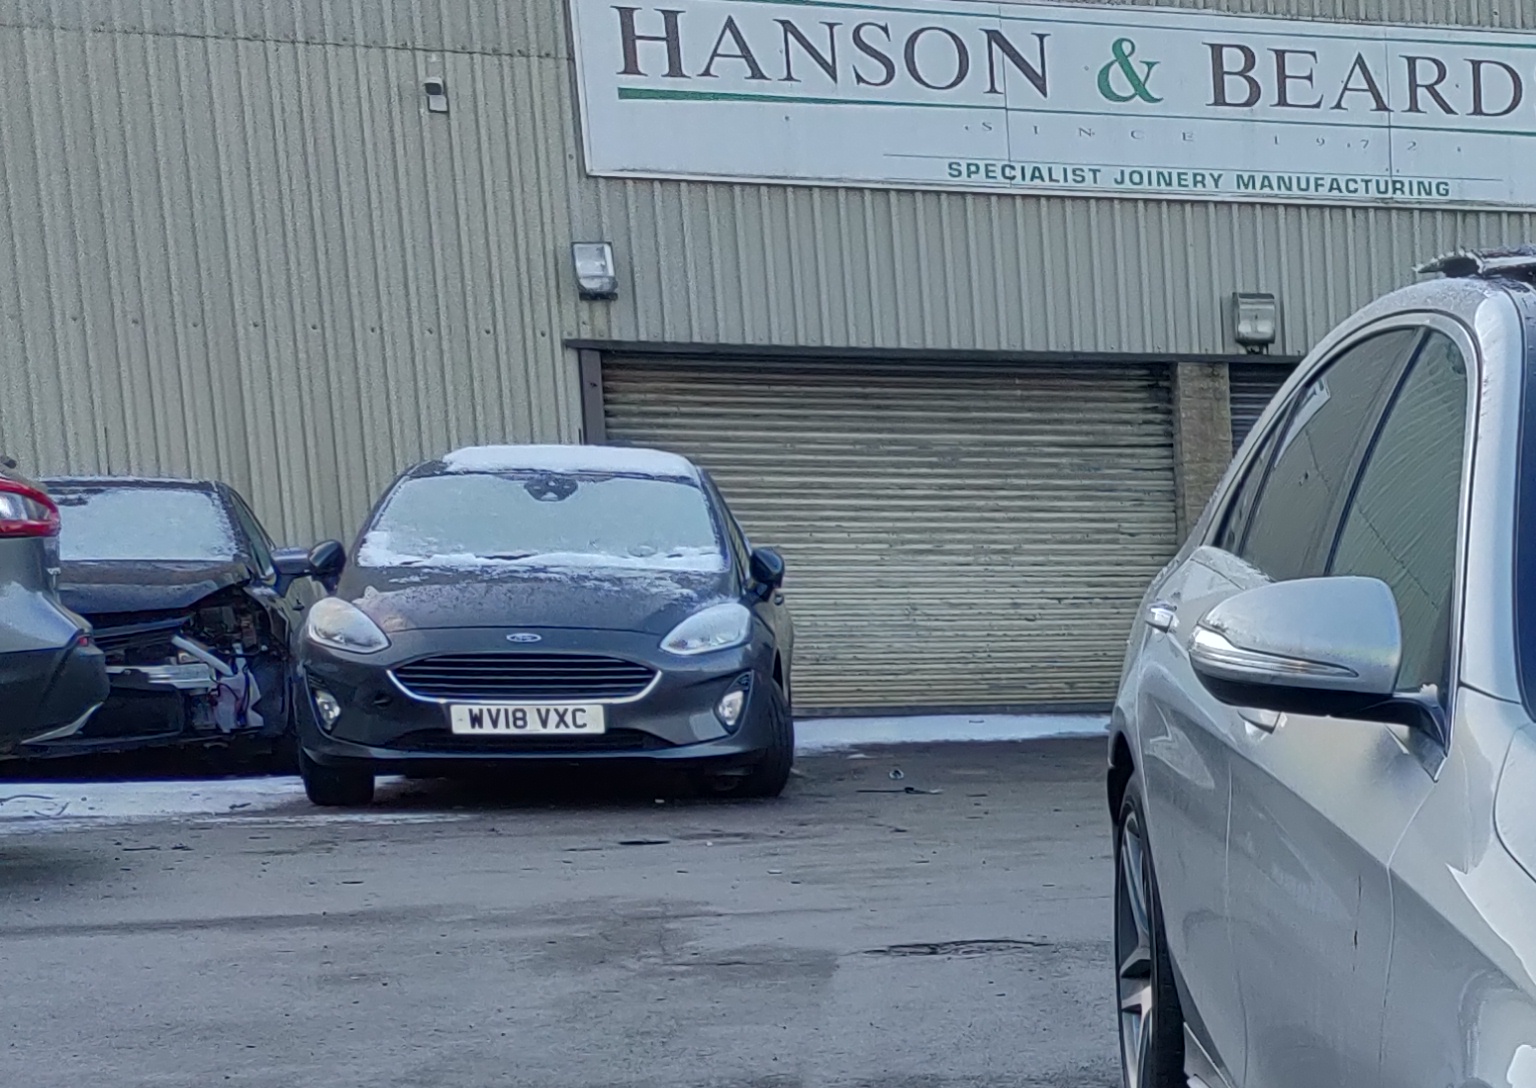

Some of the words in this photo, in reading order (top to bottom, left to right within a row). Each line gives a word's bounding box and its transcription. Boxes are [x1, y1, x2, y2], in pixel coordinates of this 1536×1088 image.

[615, 6, 1051, 99] HANSON
[1097, 36, 1164, 104] &
[947, 160, 1102, 186] SPECIALIST
[1113, 168, 1224, 190] JOINERY
[1235, 173, 1451, 198] MANUFACTURING
[468, 707, 528, 730] WV18
[536, 707, 588, 730] VXC
